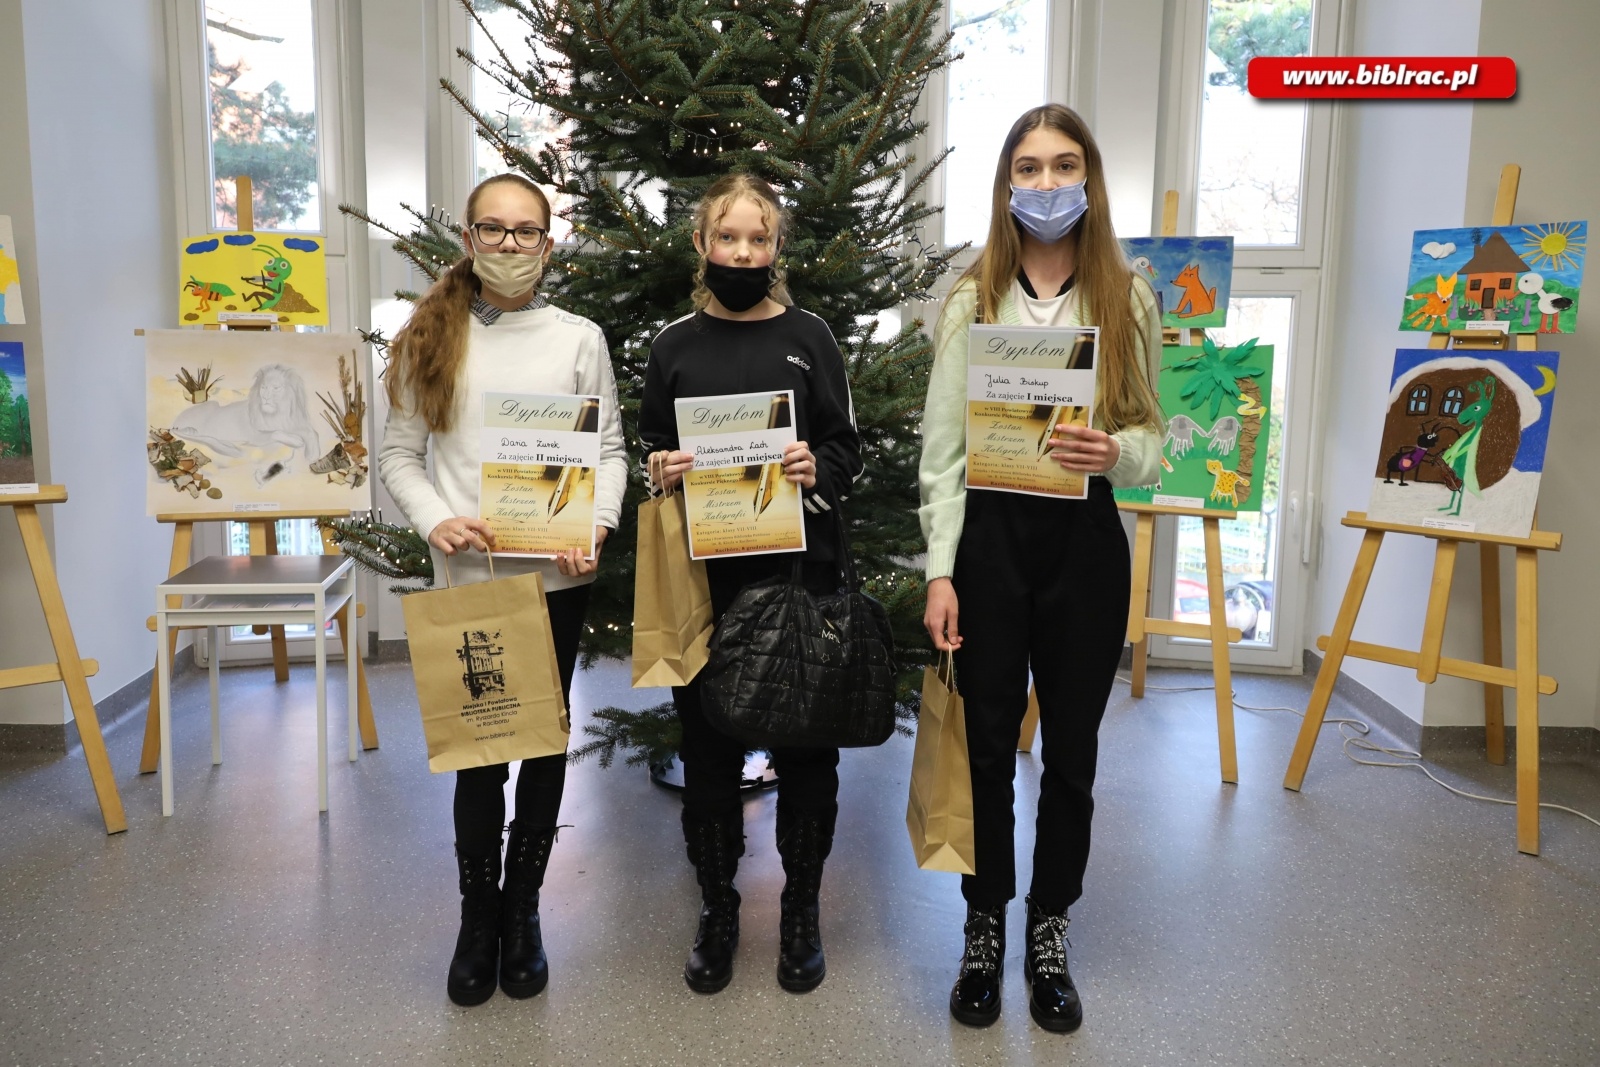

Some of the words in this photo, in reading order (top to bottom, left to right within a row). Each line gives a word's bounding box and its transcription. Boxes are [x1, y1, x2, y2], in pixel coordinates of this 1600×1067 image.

[984, 336, 1066, 361] Dyplom
[786, 355, 810, 370] adidas
[984, 374, 1010, 388] Julia
[1020, 377, 1049, 389] Biskup
[986, 390, 996, 398] Za
[998, 392, 1025, 400] zajęcie
[1034, 393, 1073, 404] miejsca
[498, 400, 574, 422] Dyplom
[692, 404, 764, 429] Dyplom
[501, 437, 528, 447] Daria
[984, 432, 1026, 442] Mistrzem
[694, 445, 744, 456] Aleksandra
[980, 444, 1030, 457] Kaligrafii
[496, 452, 508, 460] Za
[508, 452, 534, 463] zajęcie
[536, 453, 545, 462] II
[546, 454, 583, 464] miejsca
[706, 458, 731, 467] zajęcie
[732, 456, 745, 464] III
[746, 452, 783, 462] miejsca
[496, 494, 536, 505] Mistrzem
[702, 500, 742, 509] Mistrzem
[492, 507, 541, 519] Kaligrafii
[702, 510, 747, 521] Kaligrafii
[488, 697, 518, 706] Powiatowa
[461, 708, 490, 717] BIBLIOTEKA
[492, 702, 521, 712] PUBLICZNA
[476, 713, 500, 722] Ryszarda
[483, 718, 510, 727] Raciborzu
[475, 730, 516, 742] www.biblrac.pl
